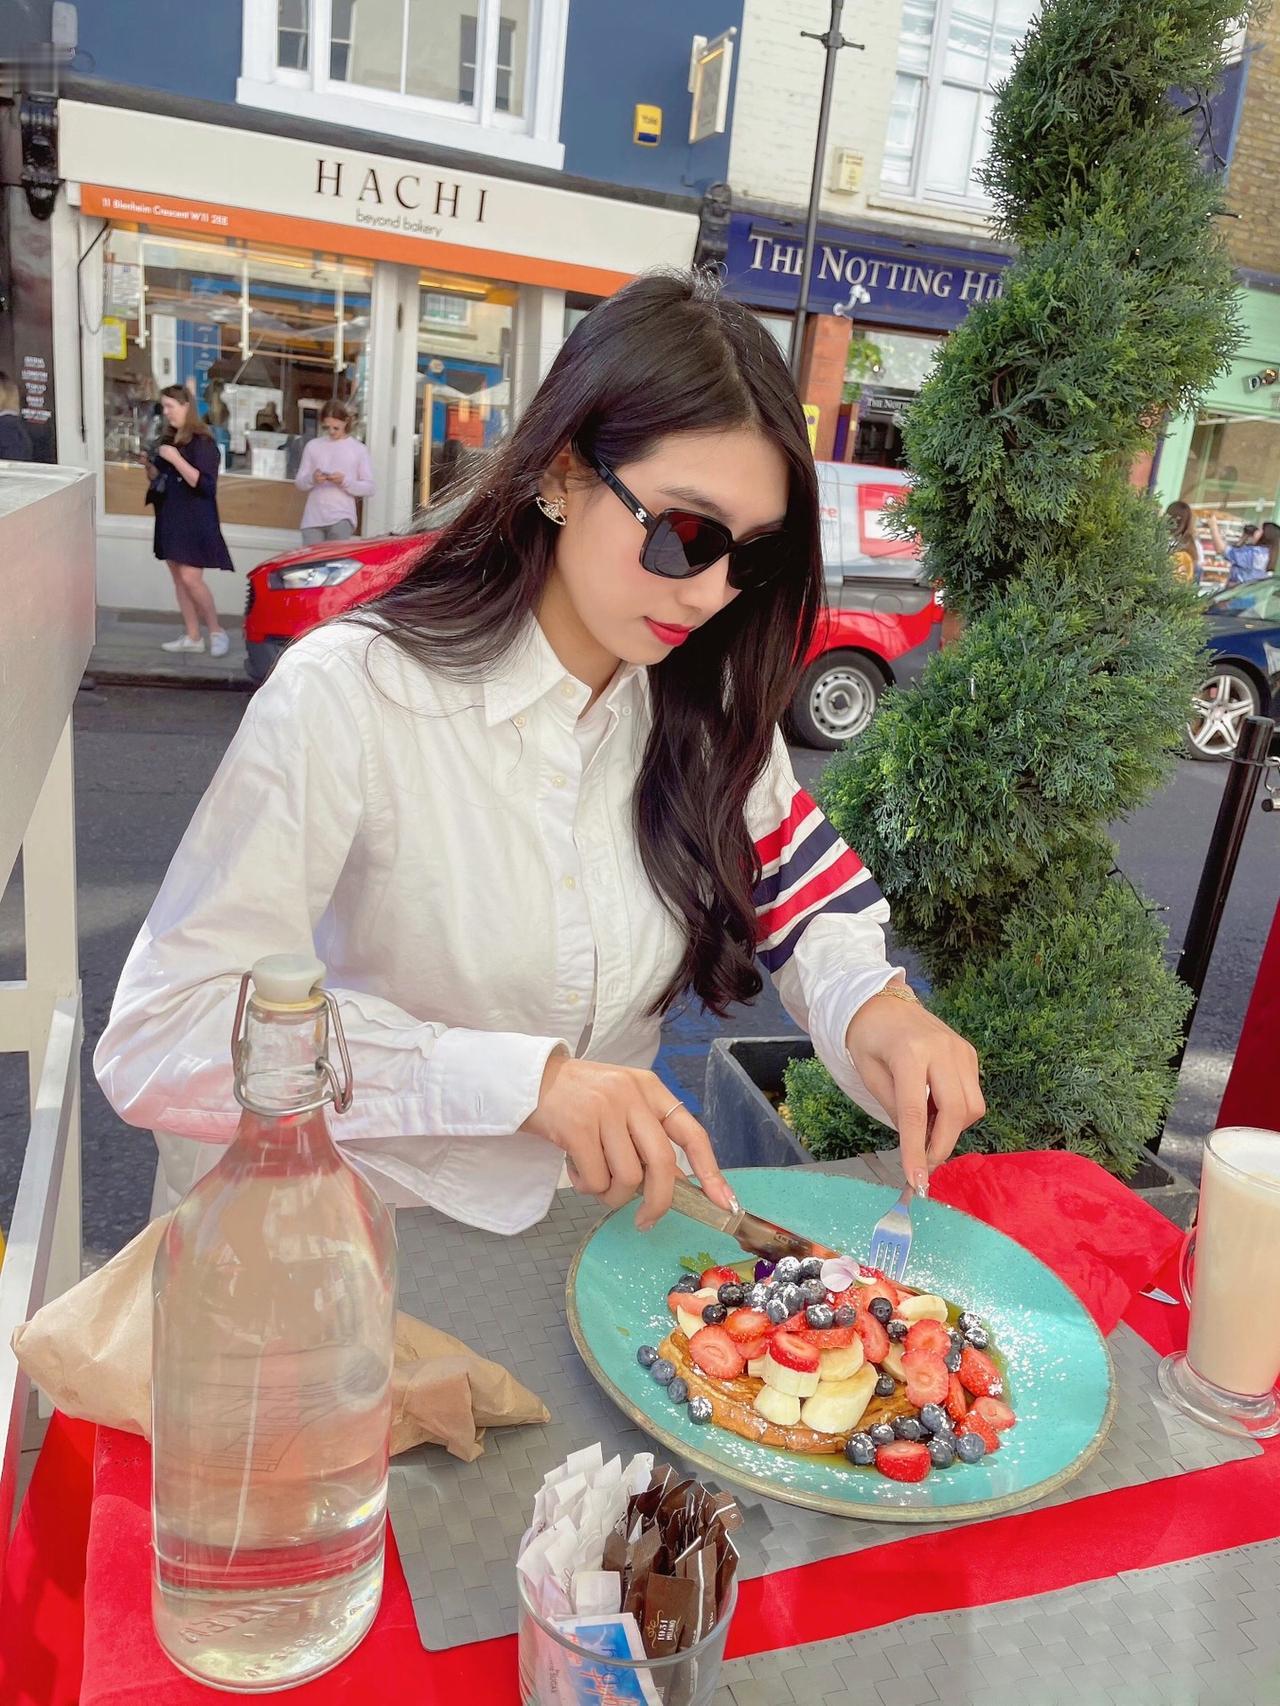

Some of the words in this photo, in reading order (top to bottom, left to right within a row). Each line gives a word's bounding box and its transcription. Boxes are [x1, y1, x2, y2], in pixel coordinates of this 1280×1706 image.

[314, 159, 488, 223] HACHI
[355, 208, 400, 229] beyond
[403, 215, 444, 238] bakery
[817, 245, 953, 299] NOTTING
[666, 1619, 677, 1641] MILANO
